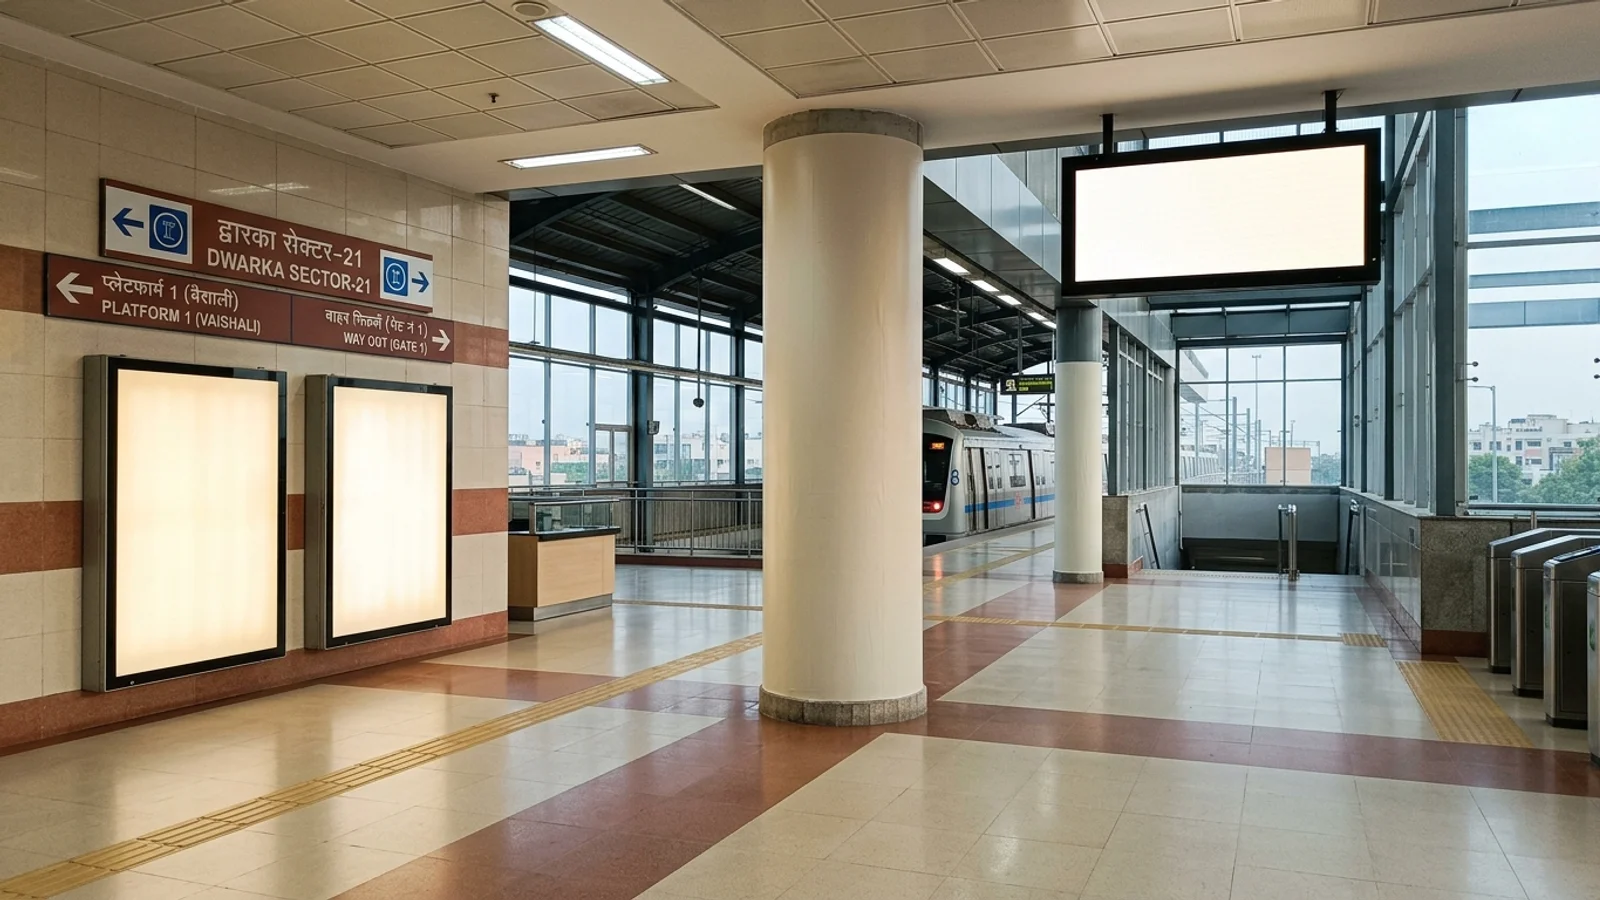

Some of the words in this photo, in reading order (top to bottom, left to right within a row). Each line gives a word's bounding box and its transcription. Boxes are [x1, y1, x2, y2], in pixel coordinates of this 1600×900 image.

[217, 219, 277, 250] द्वारका
[282, 227, 362, 268] सेक्टर-21
[207, 248, 285, 279] DWARKA
[101, 271, 164, 298] प्लेटफार्म
[169, 285, 177, 300] 1
[101, 299, 180, 323] PLATFORM
[184, 311, 191, 325] 1
[195, 312, 261, 336] (VAISHALI)
[343, 331, 366, 347] WAY
[390, 338, 418, 353] (GATE
[419, 342, 428, 356] 1)
